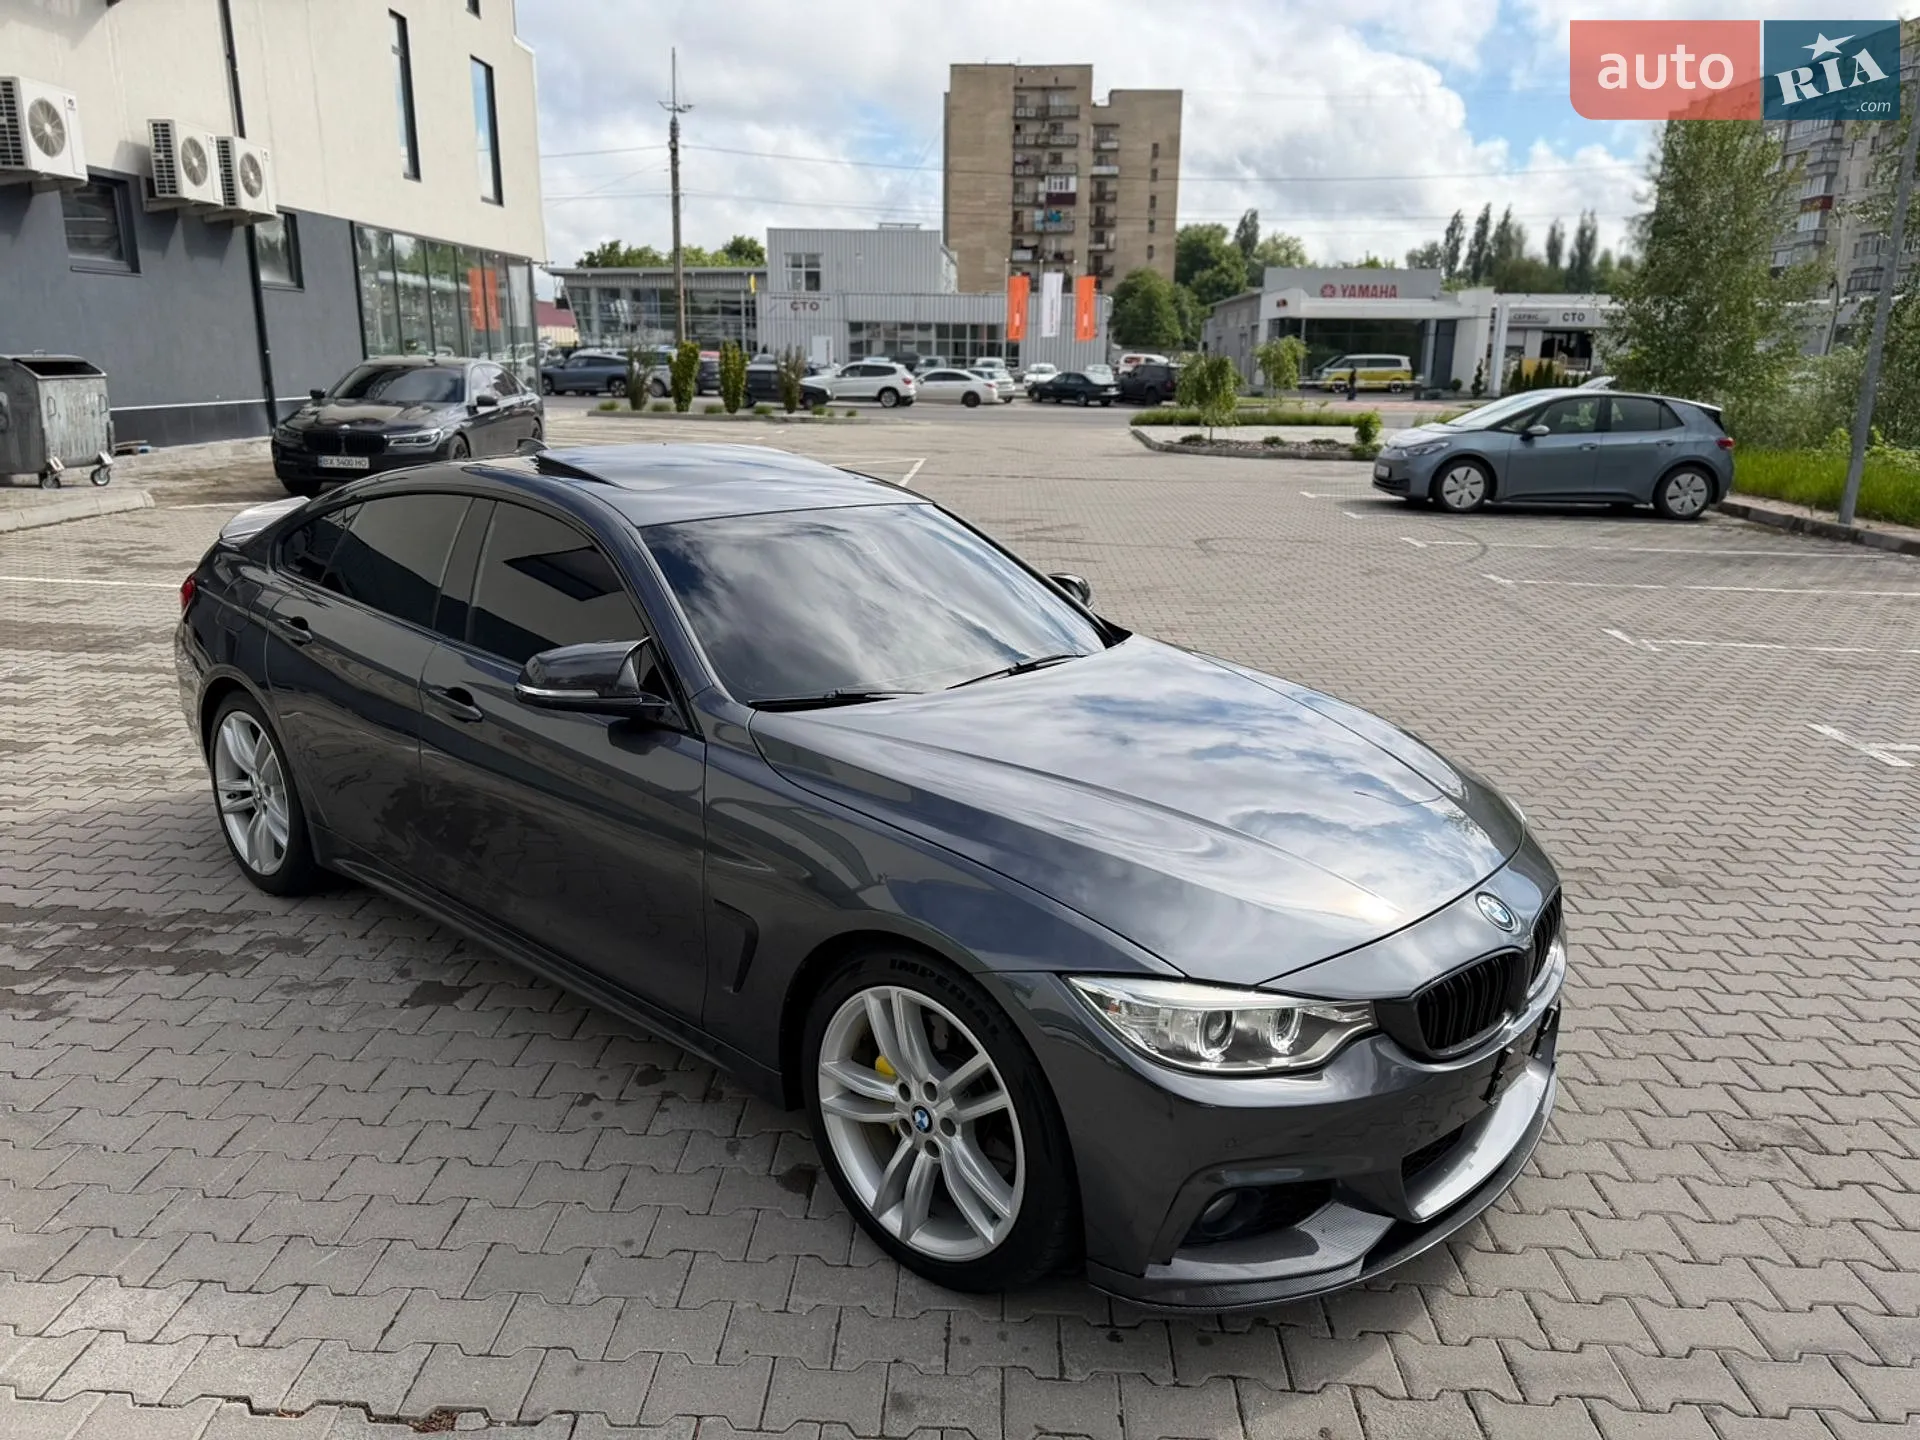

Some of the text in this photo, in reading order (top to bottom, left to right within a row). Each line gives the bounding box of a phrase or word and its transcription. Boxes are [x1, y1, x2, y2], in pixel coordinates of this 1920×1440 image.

[1340, 284, 1398, 298] YAMAHA
[790, 301, 820, 311] СТО
[1562, 312, 1586, 322] СТО
